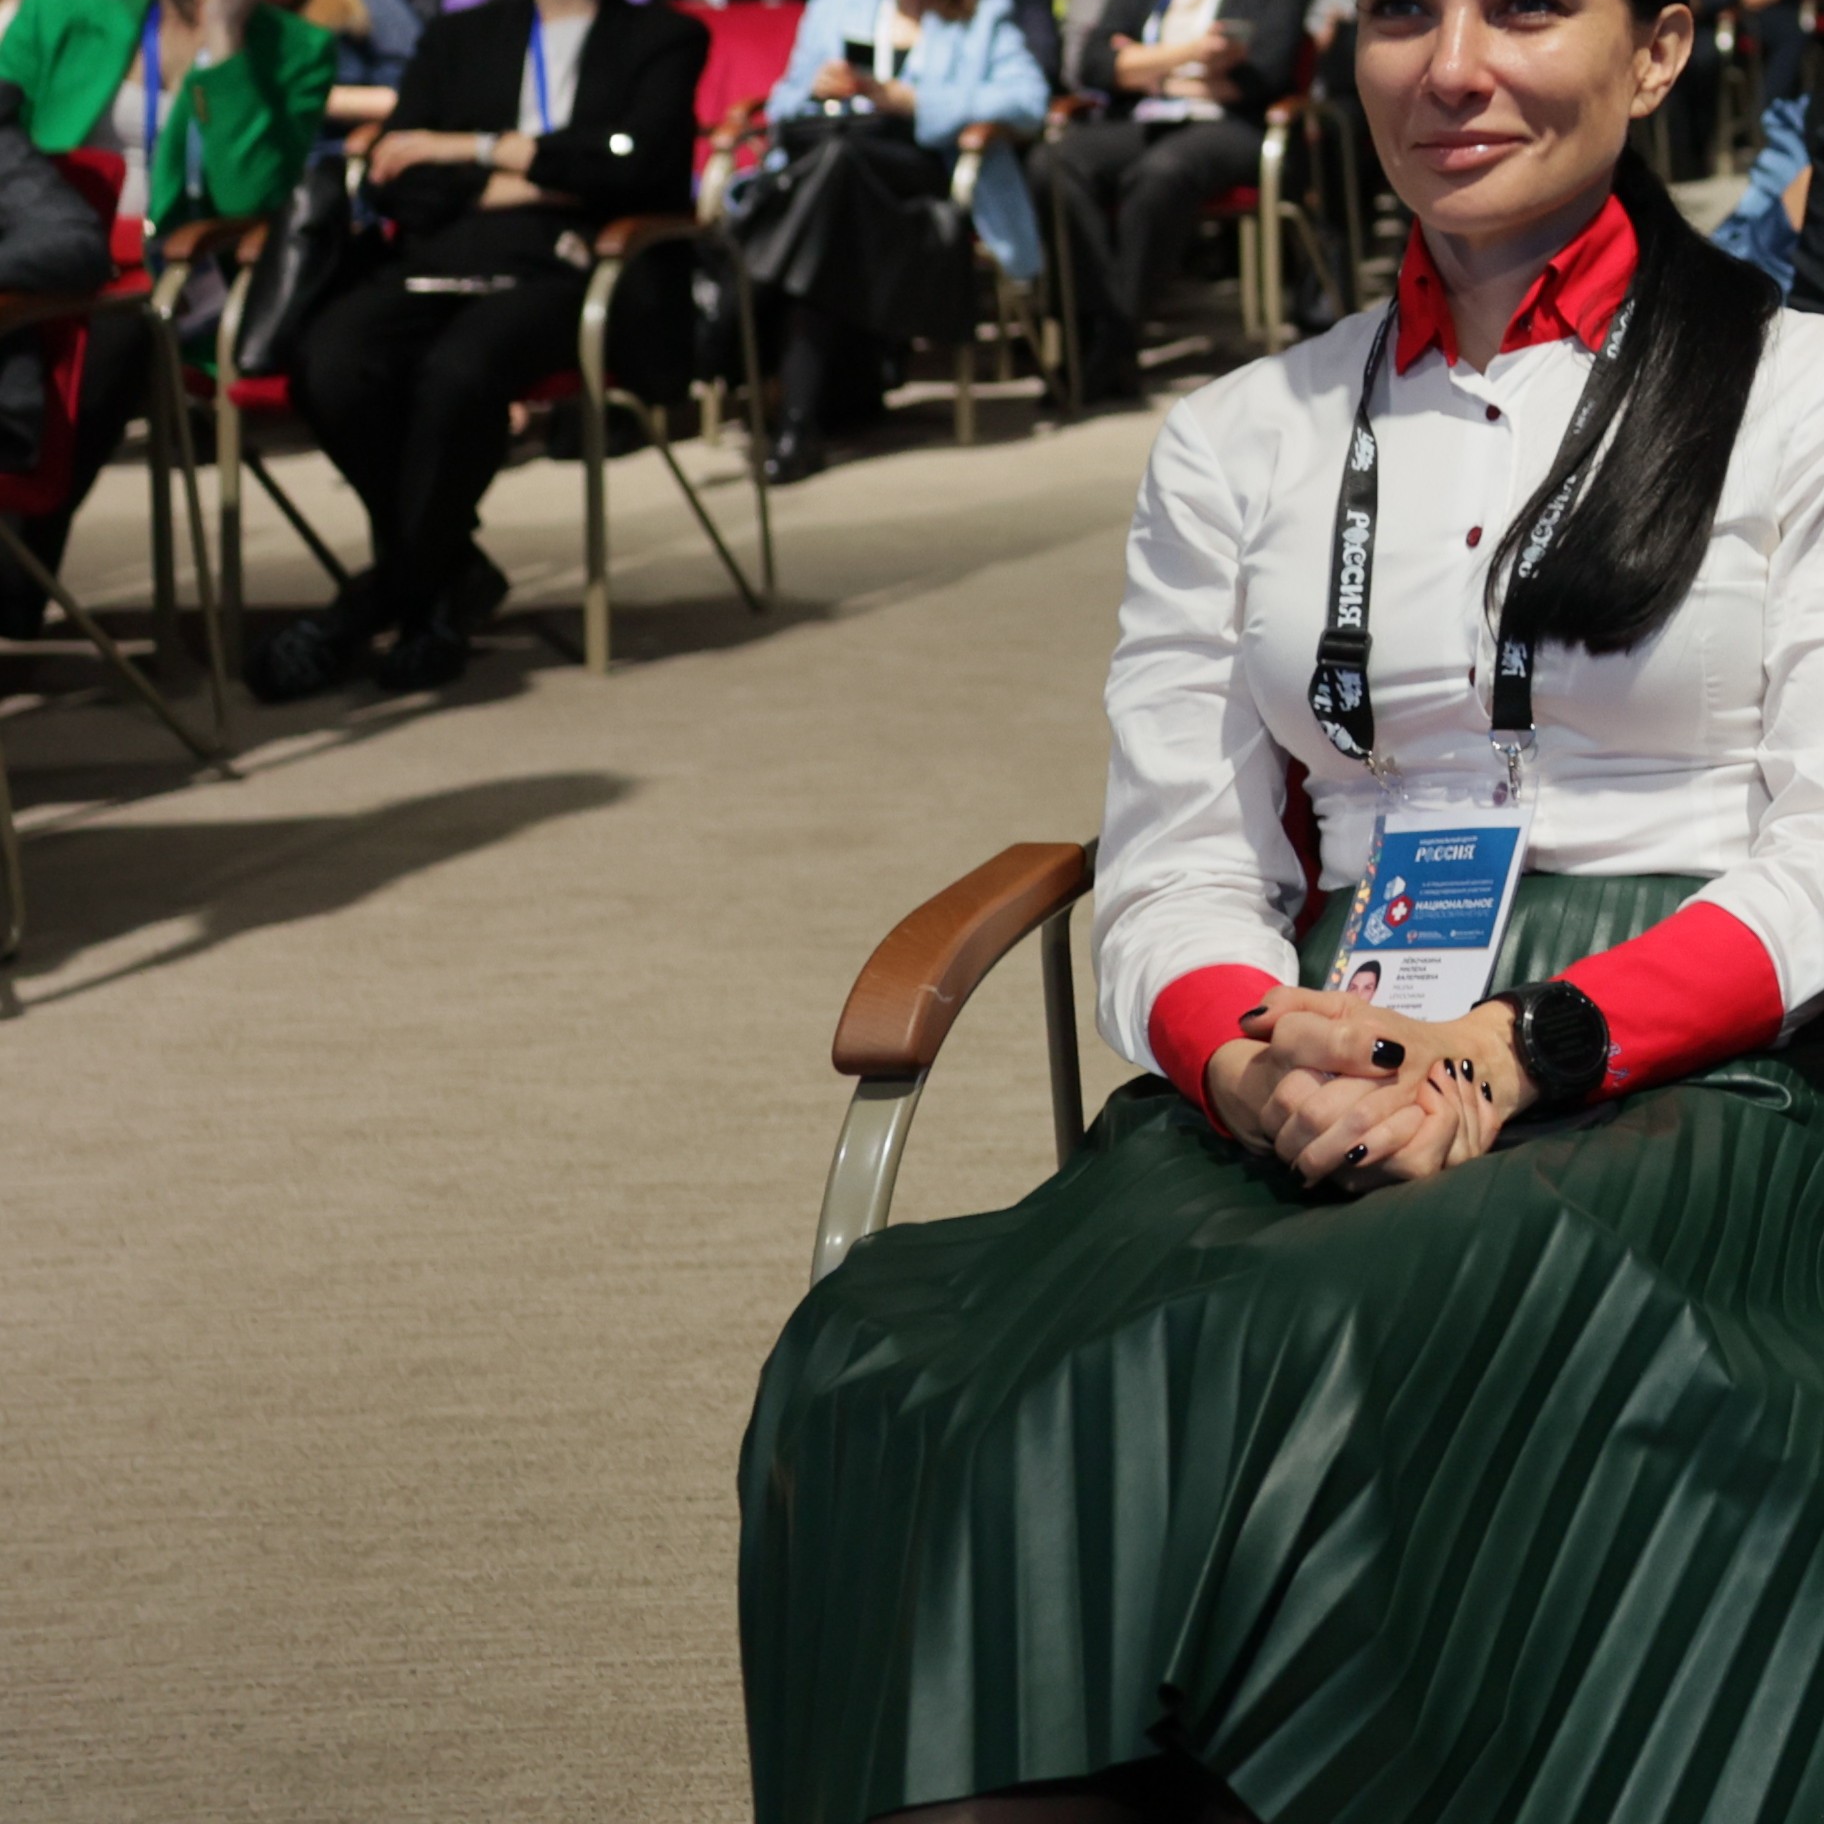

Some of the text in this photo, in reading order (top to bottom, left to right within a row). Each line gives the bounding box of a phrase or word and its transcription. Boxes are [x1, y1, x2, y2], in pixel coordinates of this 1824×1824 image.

[1338, 509, 1370, 628] РОССИЯ
[1415, 844, 1476, 863] РОССИЯ
[1414, 897, 1495, 911] НАЦИОНАЛЬНОЕ
